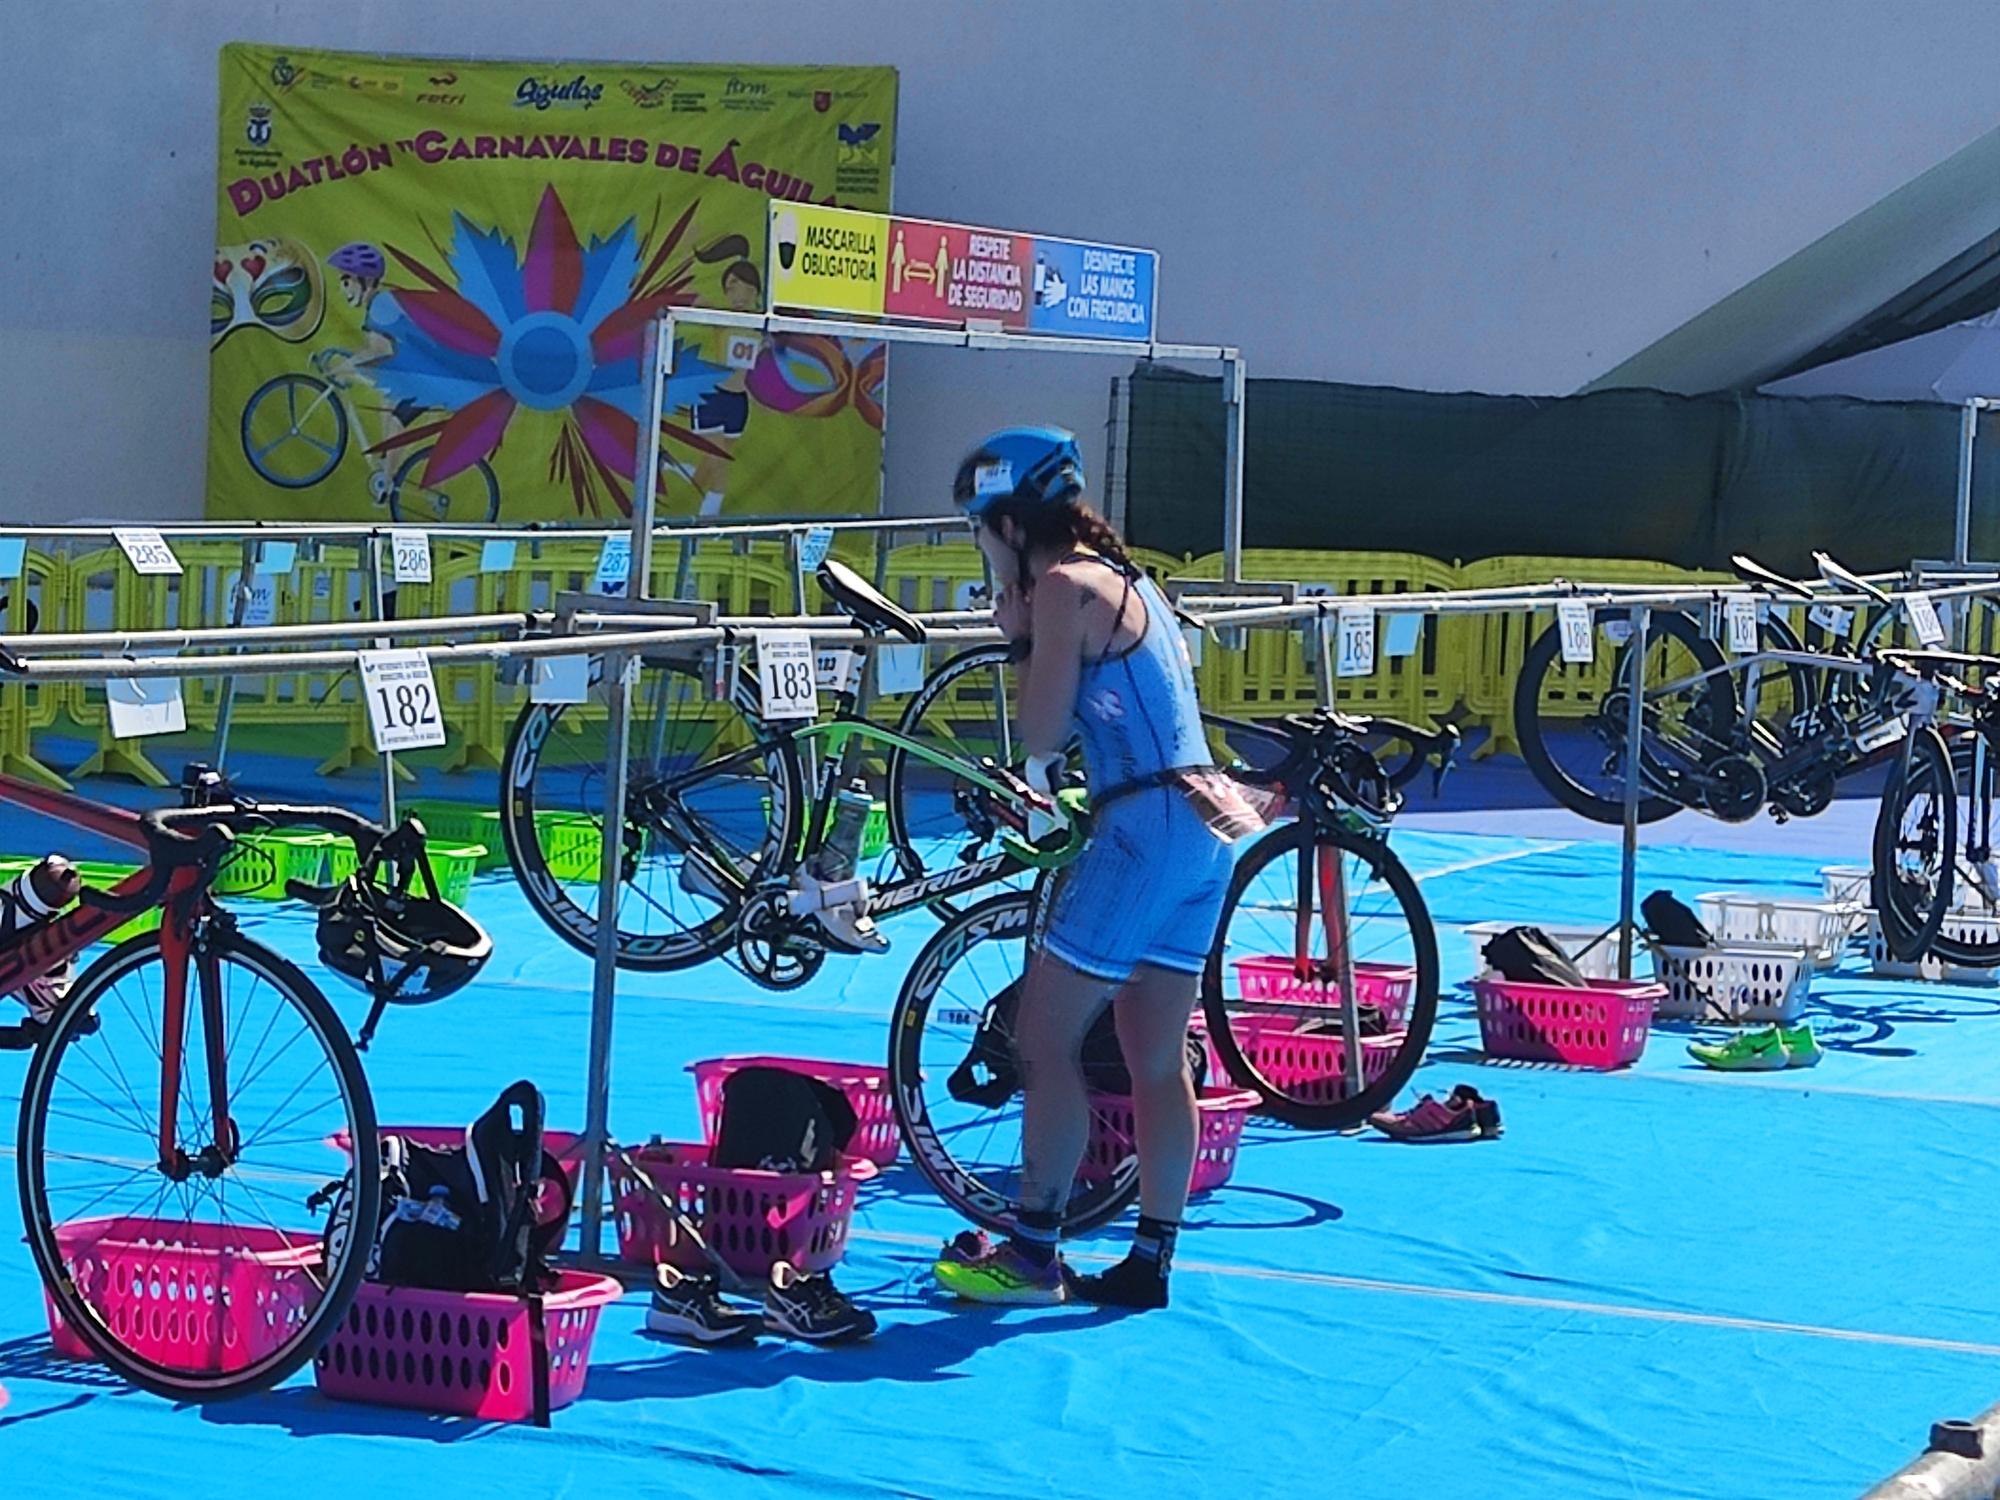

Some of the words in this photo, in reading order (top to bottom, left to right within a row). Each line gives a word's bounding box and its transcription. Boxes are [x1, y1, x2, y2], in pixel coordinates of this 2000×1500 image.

[226, 143, 393, 217] DUATLÓN
[414, 130, 648, 164] CARNAVALES
[655, 142, 702, 174] DE
[704, 137, 858, 210] ÁGUIL
[805, 225, 876, 256] MASCARILLA
[969, 234, 1011, 261] RESPETE
[802, 252, 876, 282] OBLIGATORIA
[952, 257, 967, 281] LA
[968, 260, 1022, 287] DISTANCIA
[1083, 250, 1136, 276] DESINFECTE
[948, 283, 963, 306] DE
[964, 285, 1022, 312] SEGURIDAD
[1081, 273, 1099, 296] LAS
[1100, 275, 1136, 300] MANOS
[1067, 296, 1090, 319] CON
[1091, 299, 1145, 325] FRECUENCIA
[128, 544, 171, 564] 285
[398, 549, 429, 571] 286
[602, 552, 631, 572] 287
[1734, 615, 1755, 640] 187
[1344, 631, 1372, 661] 185
[769, 662, 812, 700] 183
[377, 683, 436, 729] 182
[864, 854, 1006, 917] MERIDA
